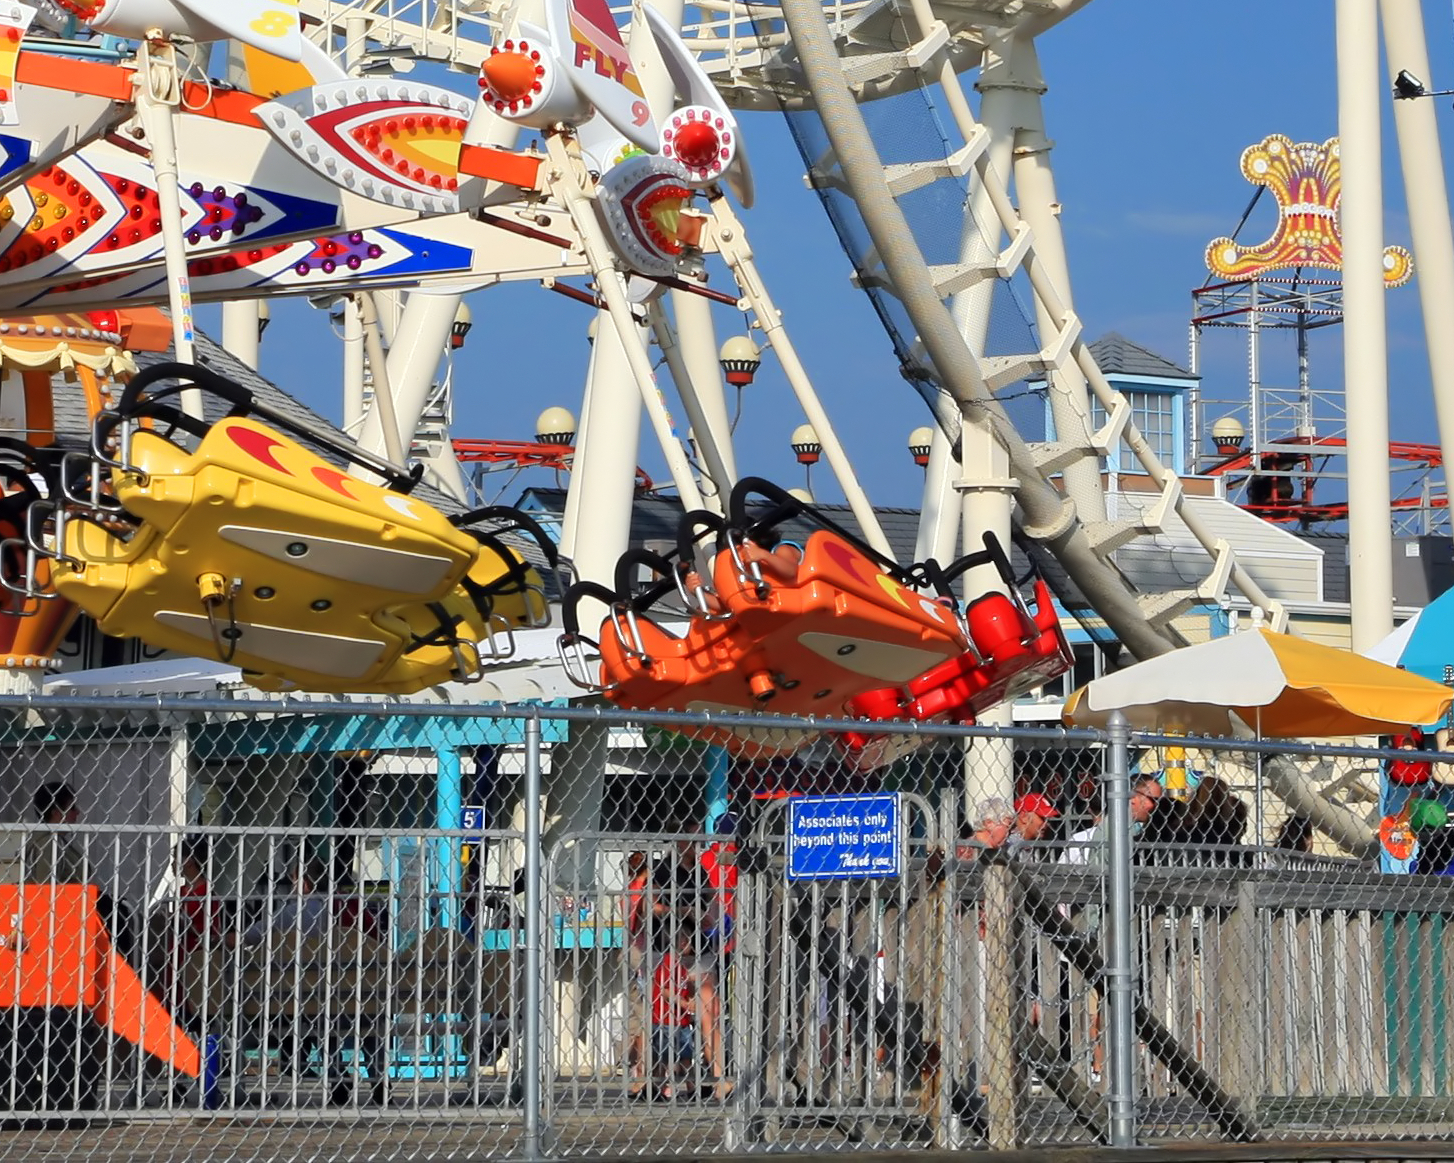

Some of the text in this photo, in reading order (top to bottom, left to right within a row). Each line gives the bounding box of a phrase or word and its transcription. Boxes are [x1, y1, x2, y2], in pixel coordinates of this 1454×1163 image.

[249, 10, 297, 38] 8
[574, 41, 628, 84] FLY
[631, 100, 649, 127] 9
[464, 811, 476, 829] 5
[798, 812, 888, 828] Associates only
[793, 830, 892, 849] beyond this point
